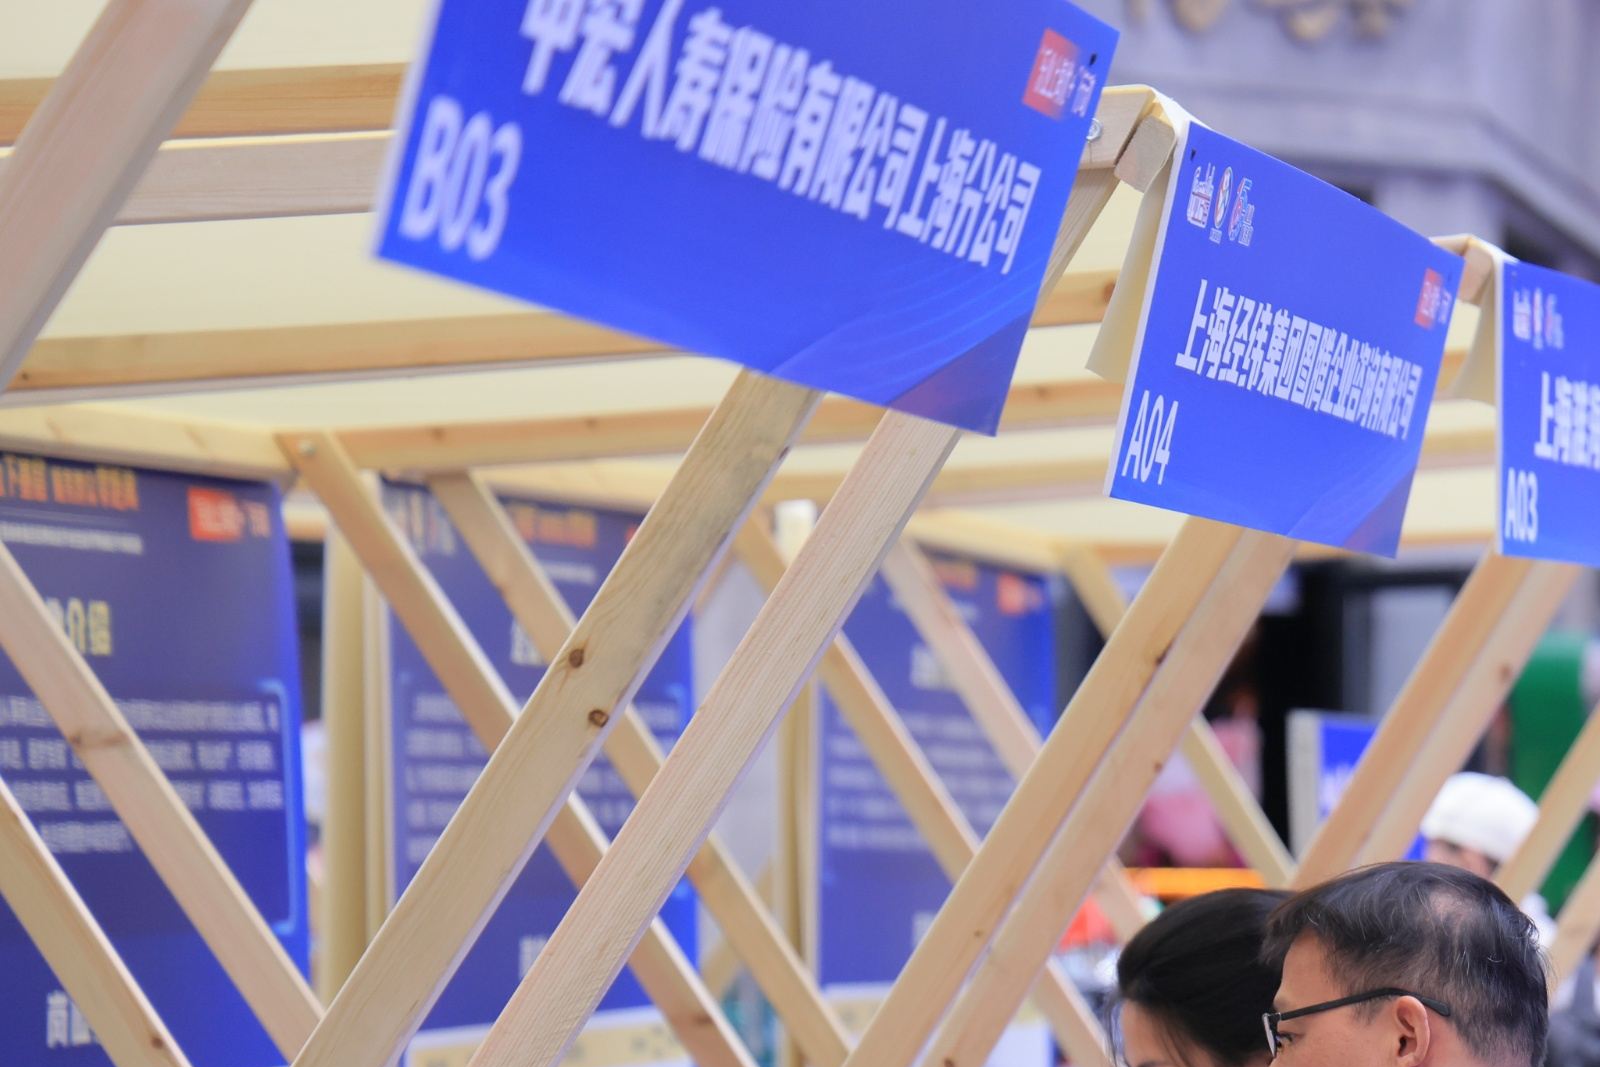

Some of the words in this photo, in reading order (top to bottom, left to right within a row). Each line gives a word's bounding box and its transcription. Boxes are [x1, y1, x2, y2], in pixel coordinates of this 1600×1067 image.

[400, 96, 522, 261] B03
[1121, 390, 1179, 485] A04
[1505, 467, 1538, 543] A03
